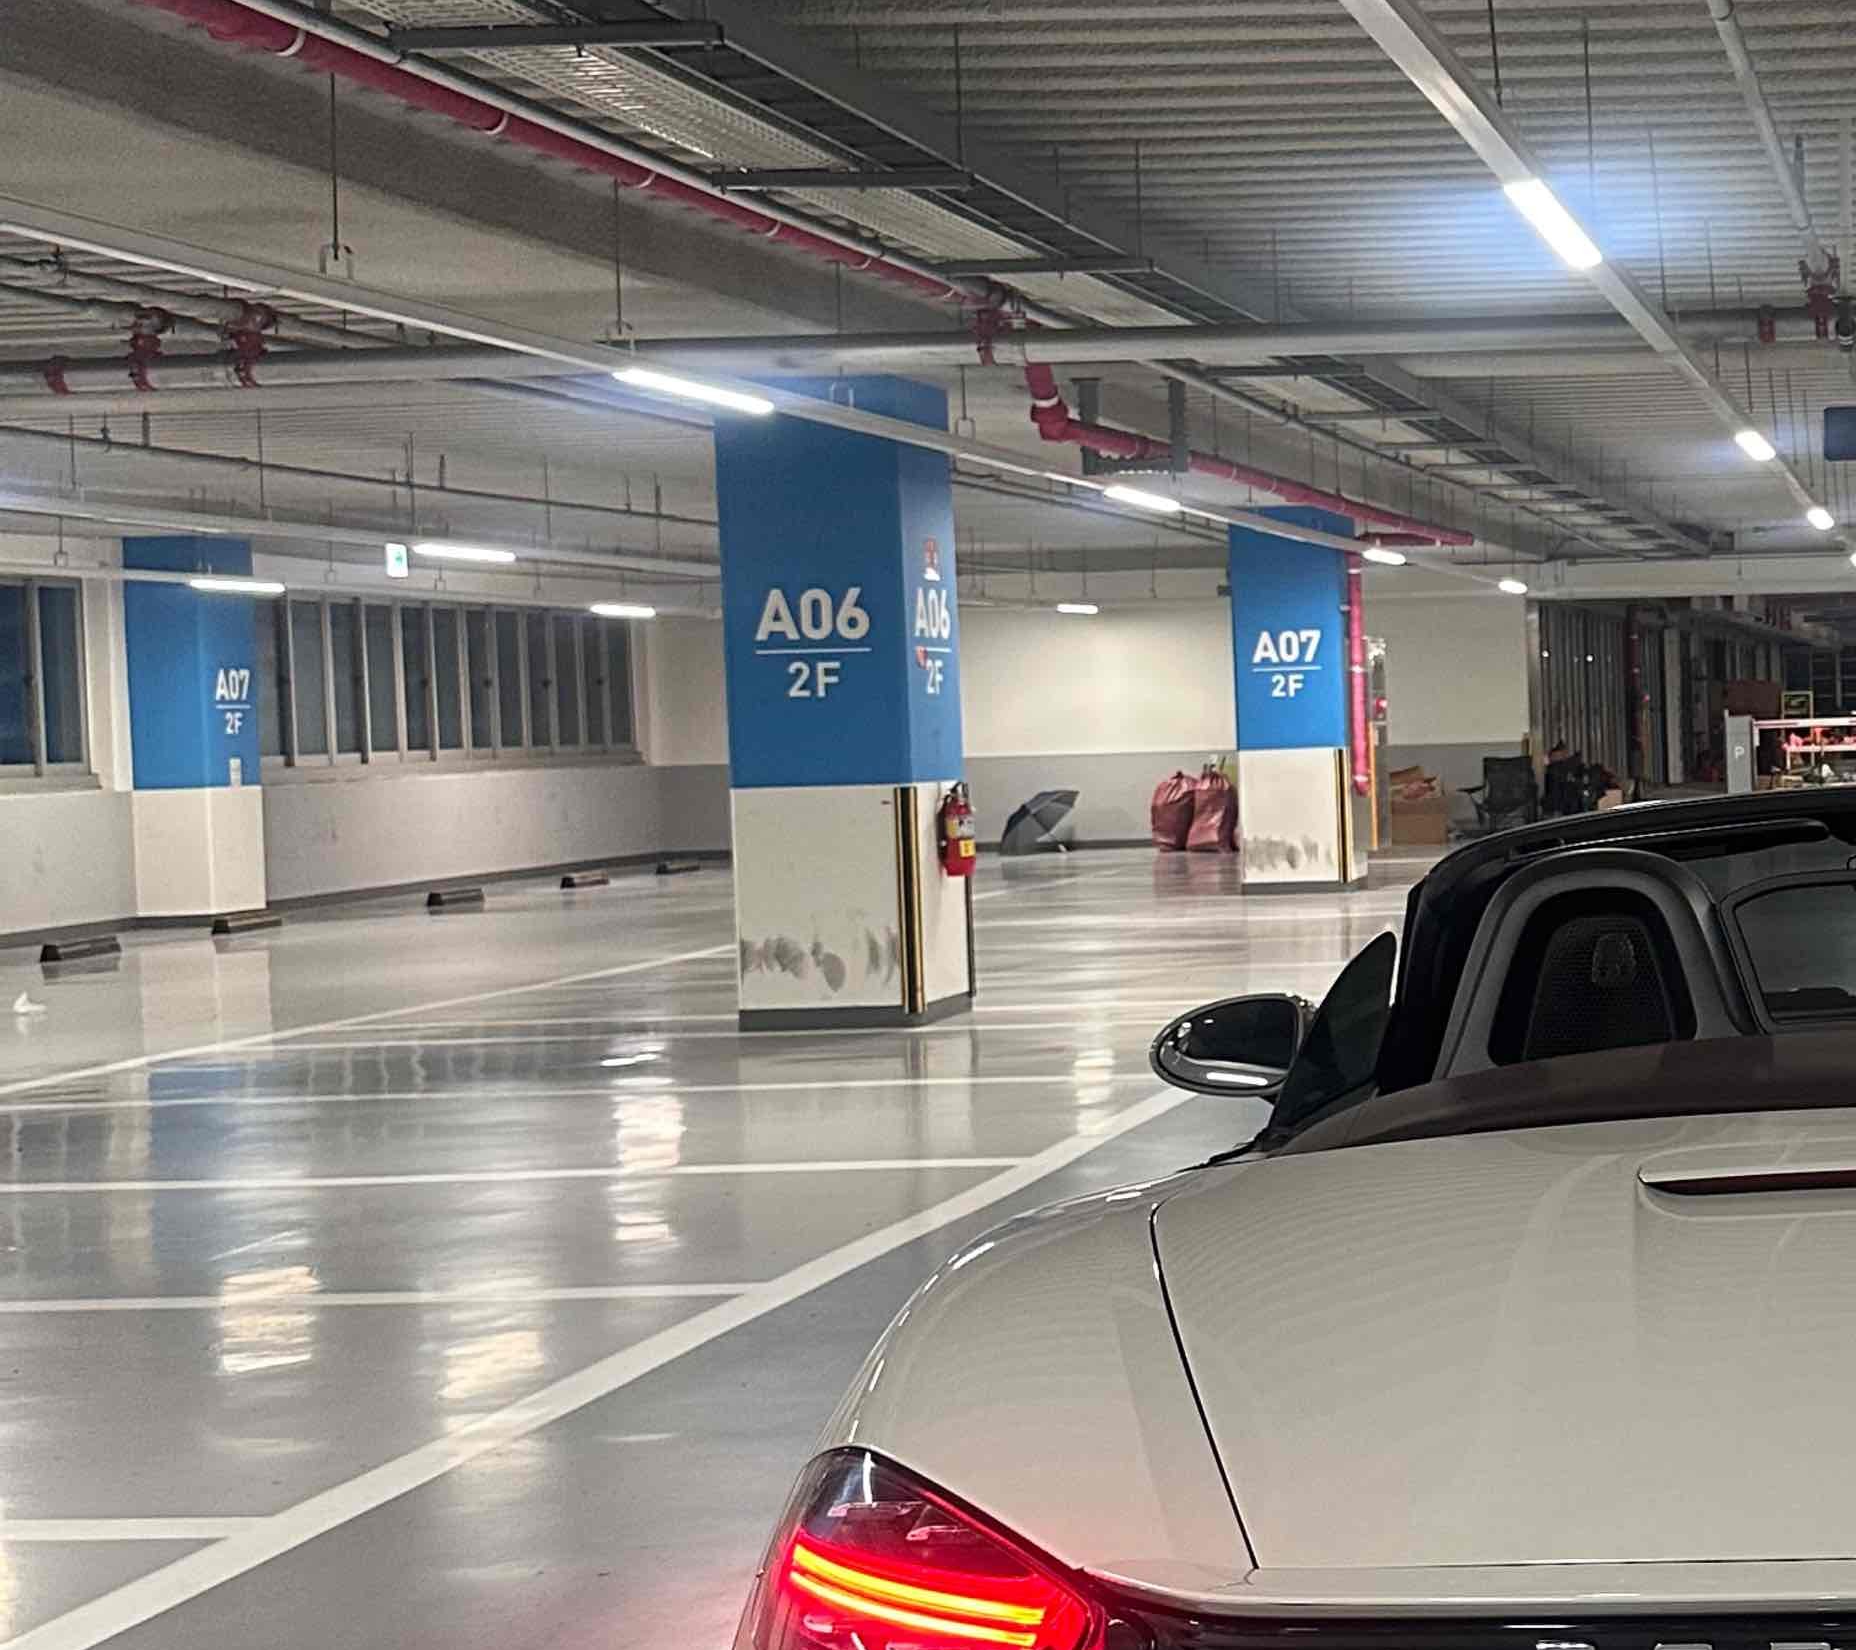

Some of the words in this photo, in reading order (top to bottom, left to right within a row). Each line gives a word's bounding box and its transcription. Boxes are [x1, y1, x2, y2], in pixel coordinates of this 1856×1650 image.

[755, 587, 870, 641] A06
[914, 587, 951, 639] A06
[1252, 629, 1321, 663] A07
[215, 668, 250, 700] A07
[788, 661, 840, 697] 2F
[927, 659, 943, 694] 2F
[1271, 673, 1304, 697] 2F
[225, 711, 243, 734] 2F
